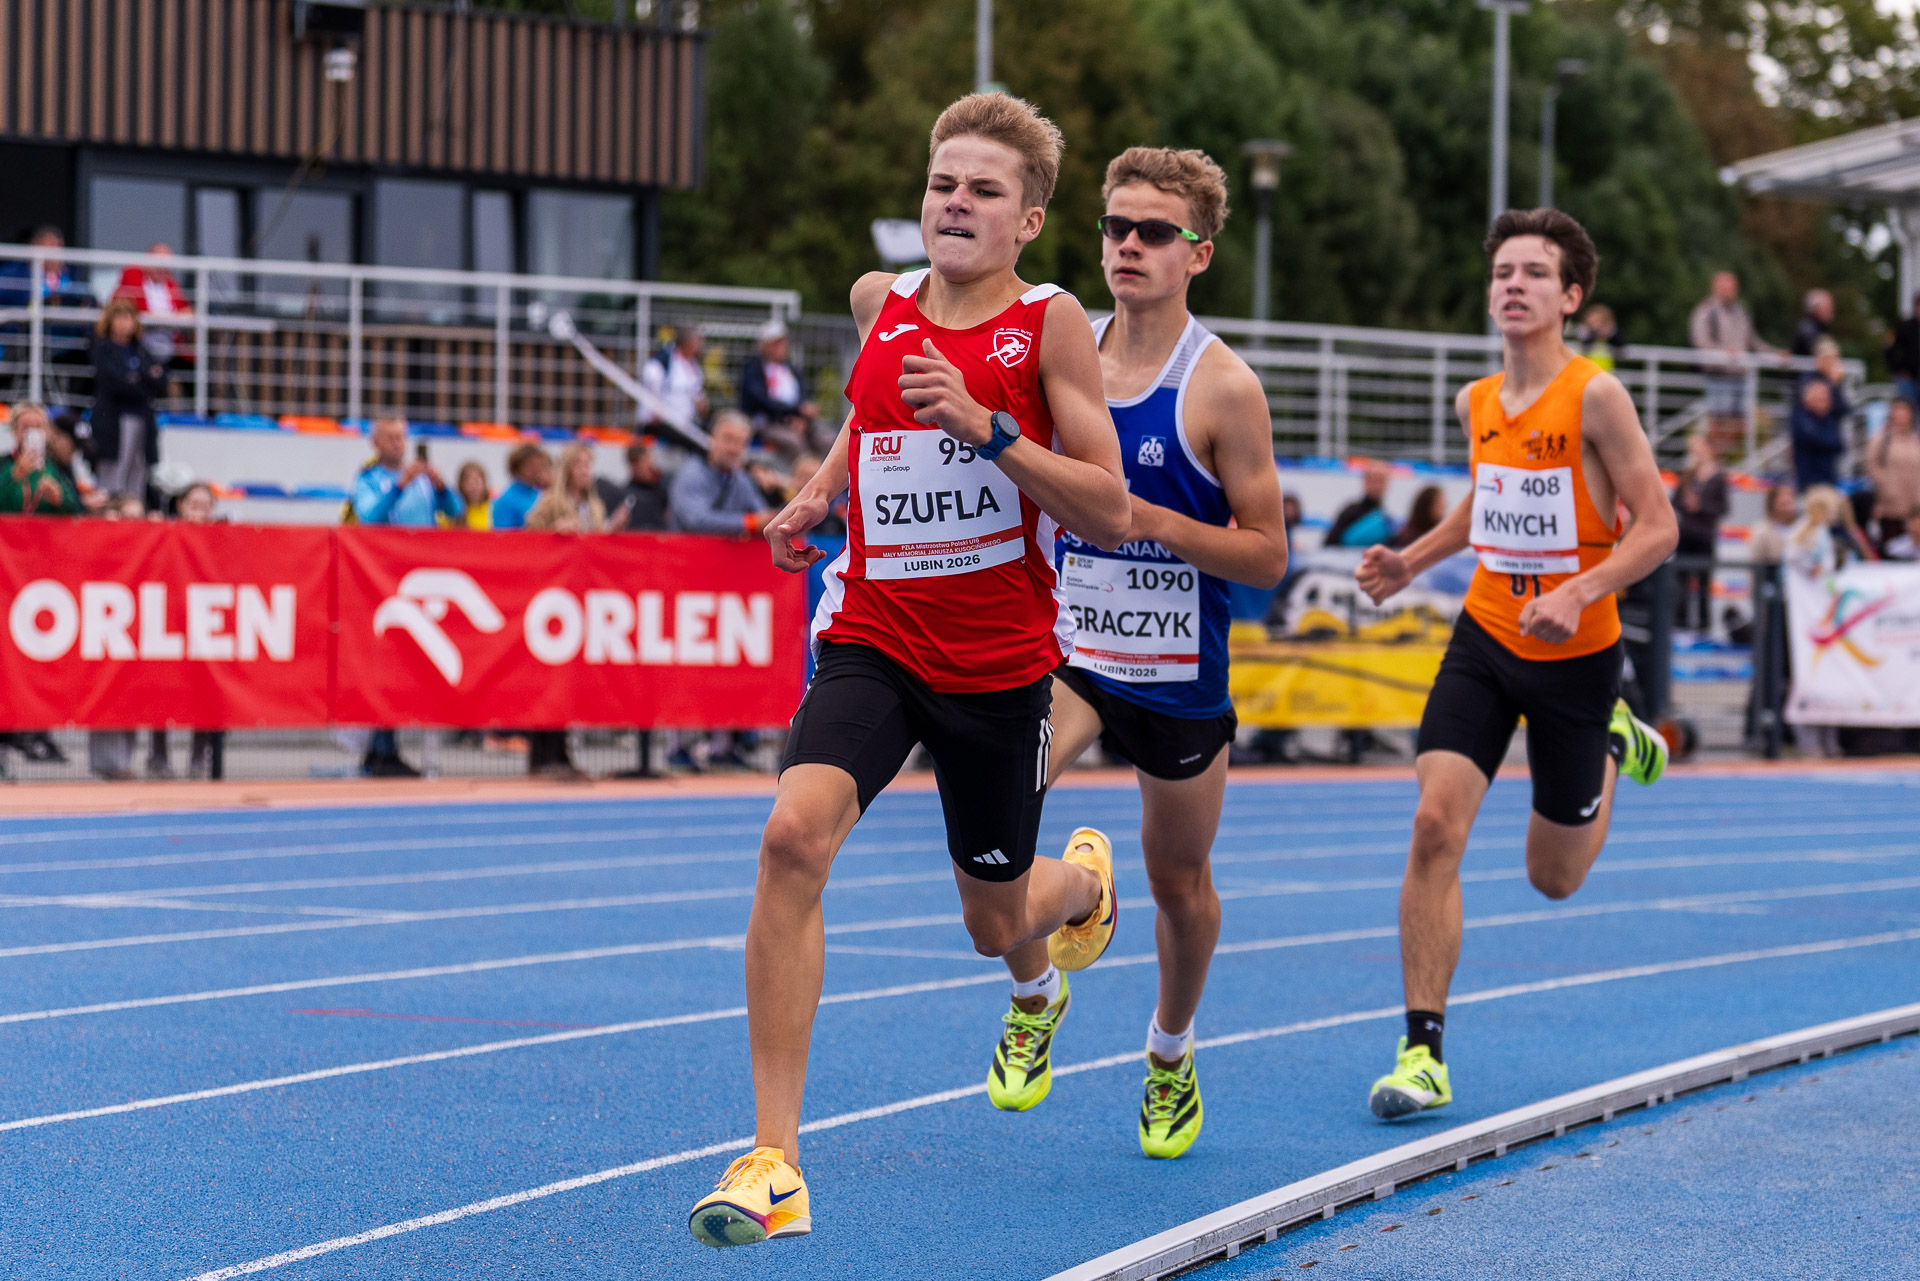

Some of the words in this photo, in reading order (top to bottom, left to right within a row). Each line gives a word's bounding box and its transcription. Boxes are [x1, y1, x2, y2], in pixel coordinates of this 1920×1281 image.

[1520, 476, 1561, 497] 408
[875, 485, 1001, 526] SZUFLA
[1484, 509, 1558, 537] KNYCH
[915, 541, 950, 550] Mistrzostwa
[950, 538, 969, 547] Polski
[927, 546, 954, 556] JANUSZA
[904, 559, 944, 572] LUBIN
[946, 554, 981, 569] 2026
[1125, 567, 1194, 593] 1090
[10, 582, 297, 661] ORLEN
[524, 589, 772, 666] ORLEN
[1068, 605, 1193, 638] GRACZYK
[1094, 662, 1127, 676] LUBIN
[1128, 667, 1158, 677] 2026
